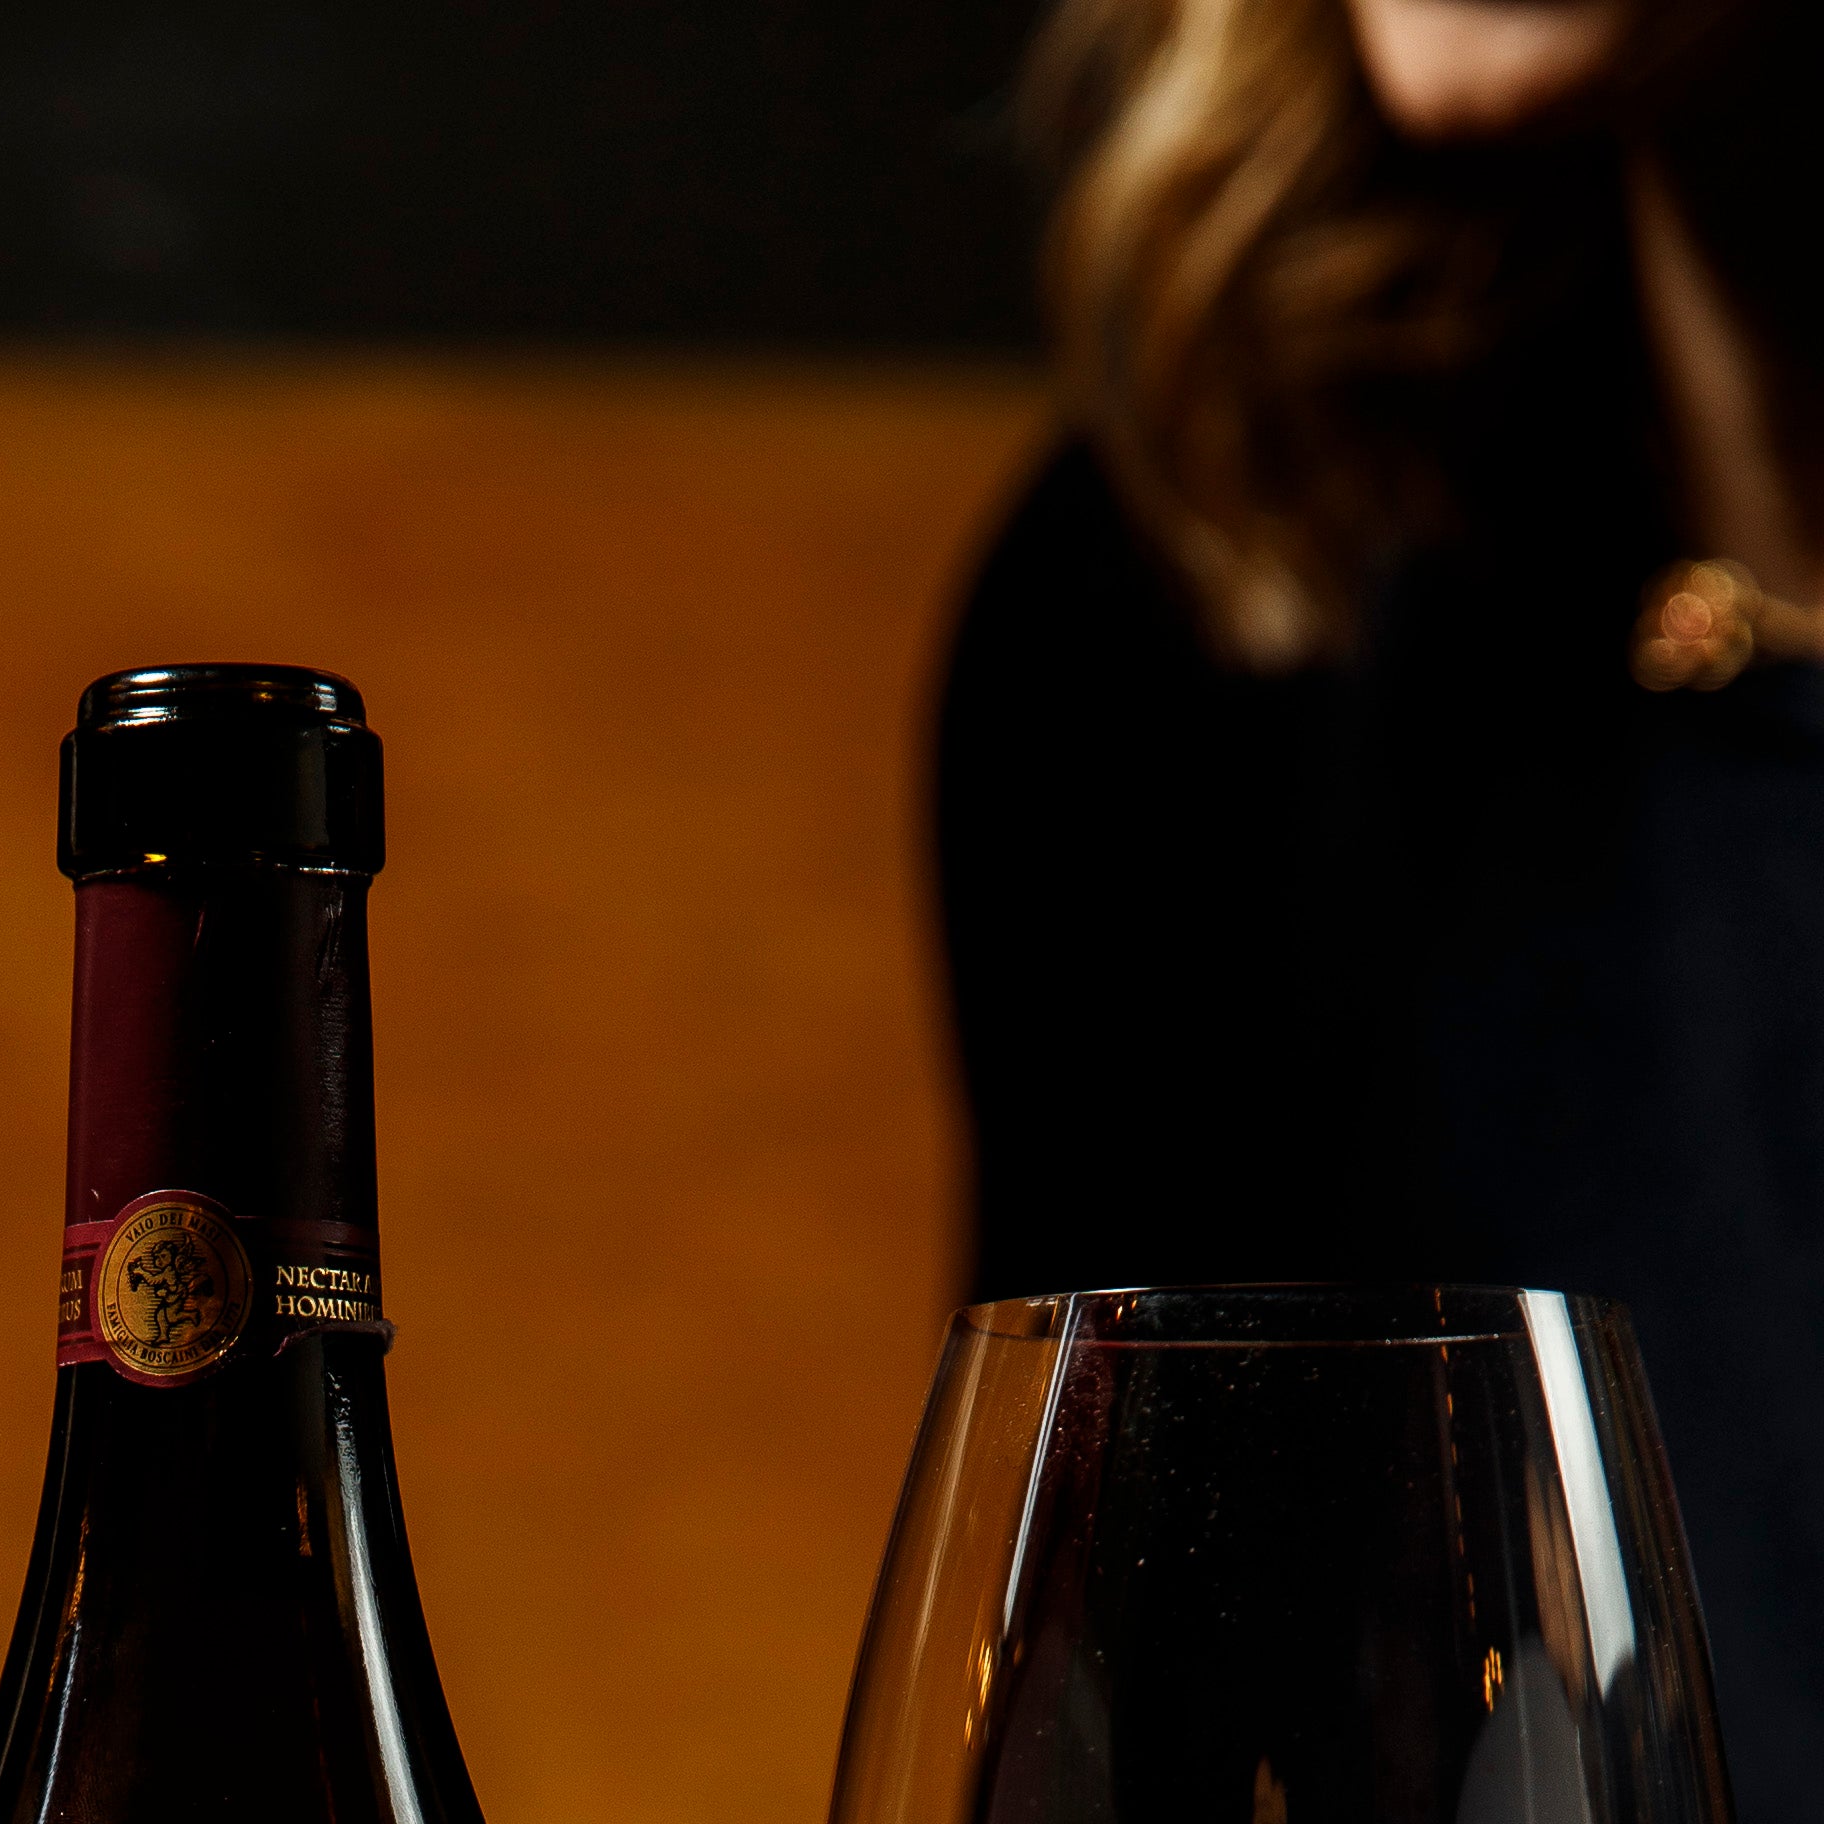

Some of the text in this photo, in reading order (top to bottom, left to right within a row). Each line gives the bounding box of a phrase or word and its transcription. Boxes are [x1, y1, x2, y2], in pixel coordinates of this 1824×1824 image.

[126, 1213, 221, 1243] VAIO DEI MASI
[106, 1302, 140, 1356] FAMIGLIA
[140, 1348, 199, 1365] BOSCAINI
